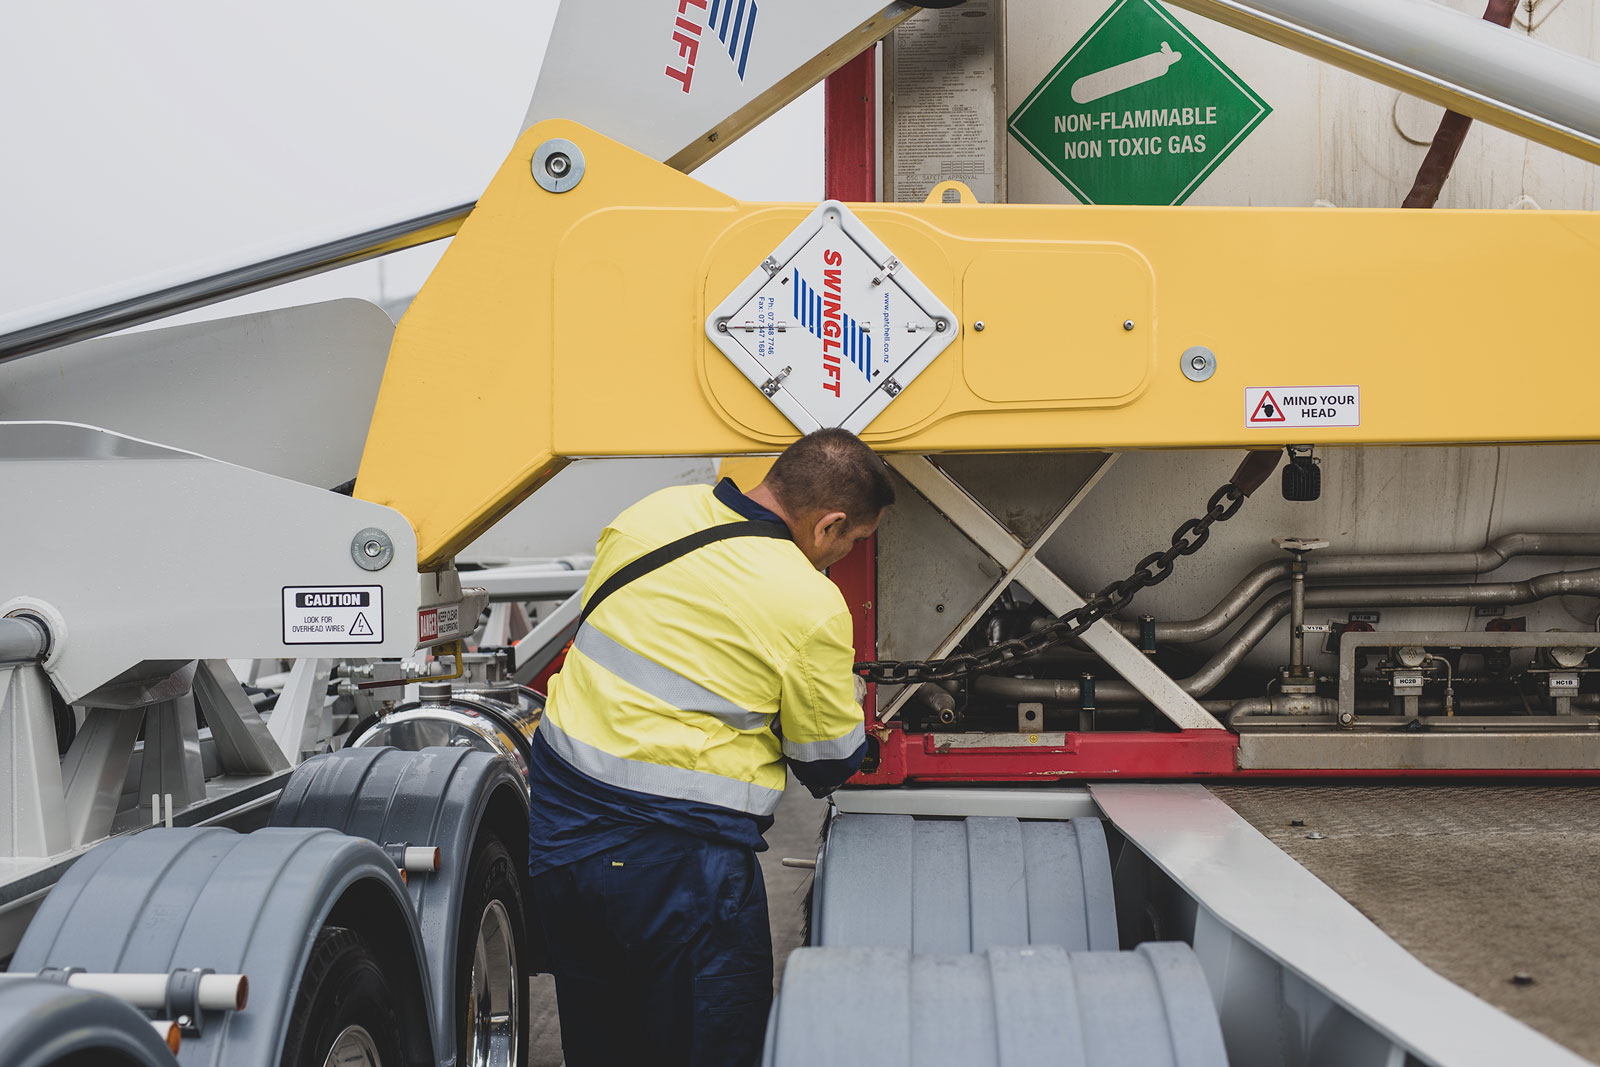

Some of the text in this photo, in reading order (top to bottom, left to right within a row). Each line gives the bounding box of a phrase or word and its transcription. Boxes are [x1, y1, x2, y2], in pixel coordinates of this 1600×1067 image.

[1054, 106, 1217, 133] NON-FLAMMABLE
[1064, 134, 1206, 160] NON TOXIC GAS
[758, 314, 765, 324] 07
[768, 311, 775, 321] 07
[823, 249, 842, 398] SWINGLIFT
[882, 292, 890, 363] www.patchell.co.nz
[1283, 395, 1355, 406] MIND YOUR
[1301, 408, 1337, 418] HEAD
[304, 593, 361, 606] CAUTION
[321, 615, 333, 623] FOR
[292, 624, 345, 633] OVERHEAD WIRES
[420, 613, 437, 638] DANGER
